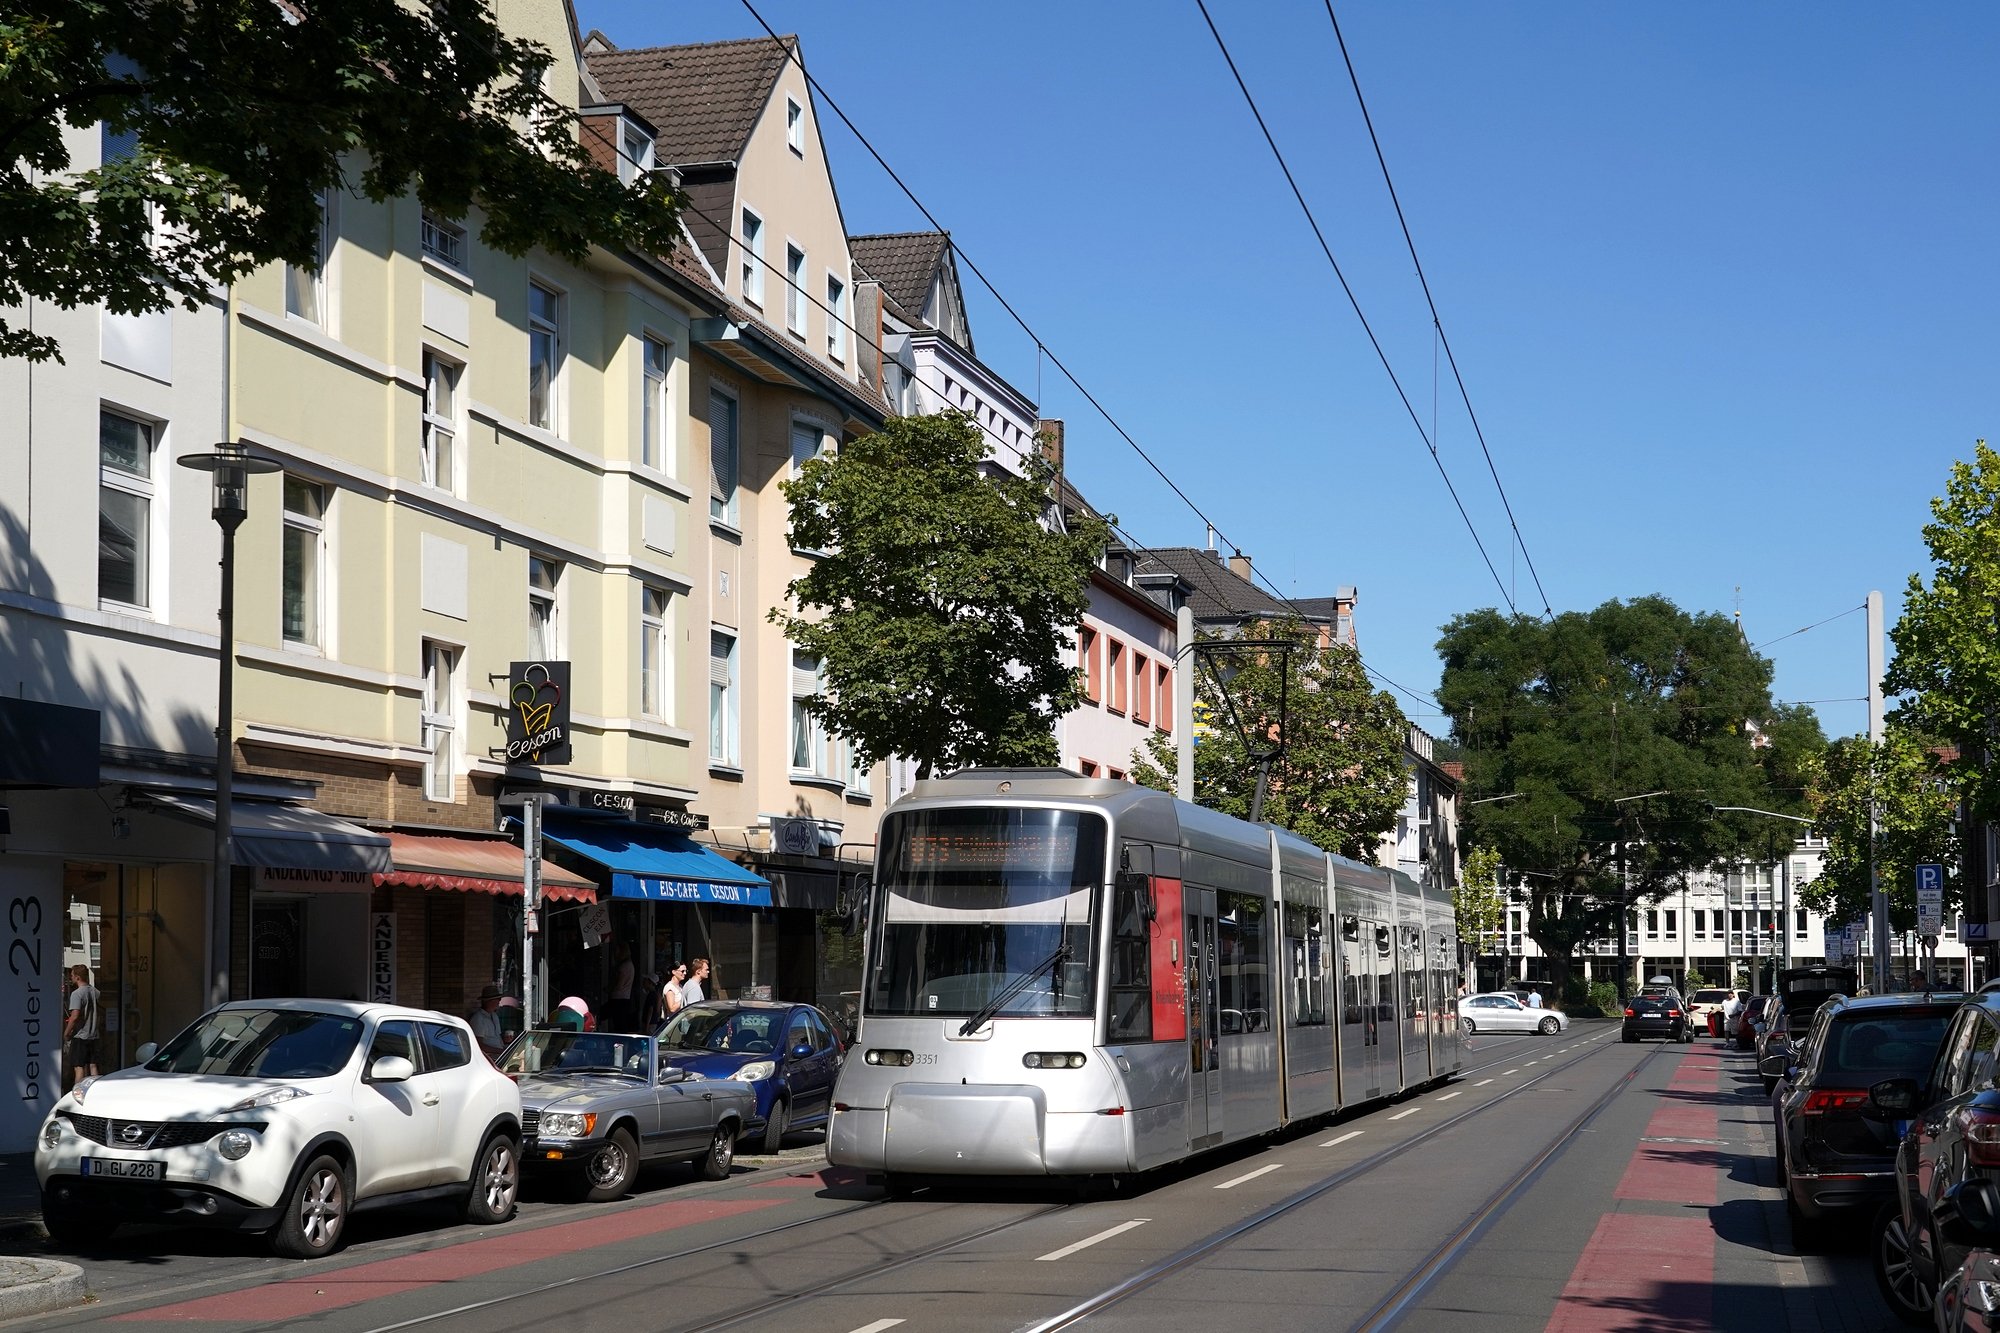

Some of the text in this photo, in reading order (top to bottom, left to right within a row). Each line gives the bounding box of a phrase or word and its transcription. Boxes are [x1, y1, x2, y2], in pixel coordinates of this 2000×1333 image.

[508, 725, 562, 759] Cescon
[1922, 868, 1936, 889] P
[709, 884, 740, 901] CESCON
[9, 896, 42, 976] 23
[915, 1053, 938, 1065] 3351
[94, 1160, 155, 1178] D GL 228
